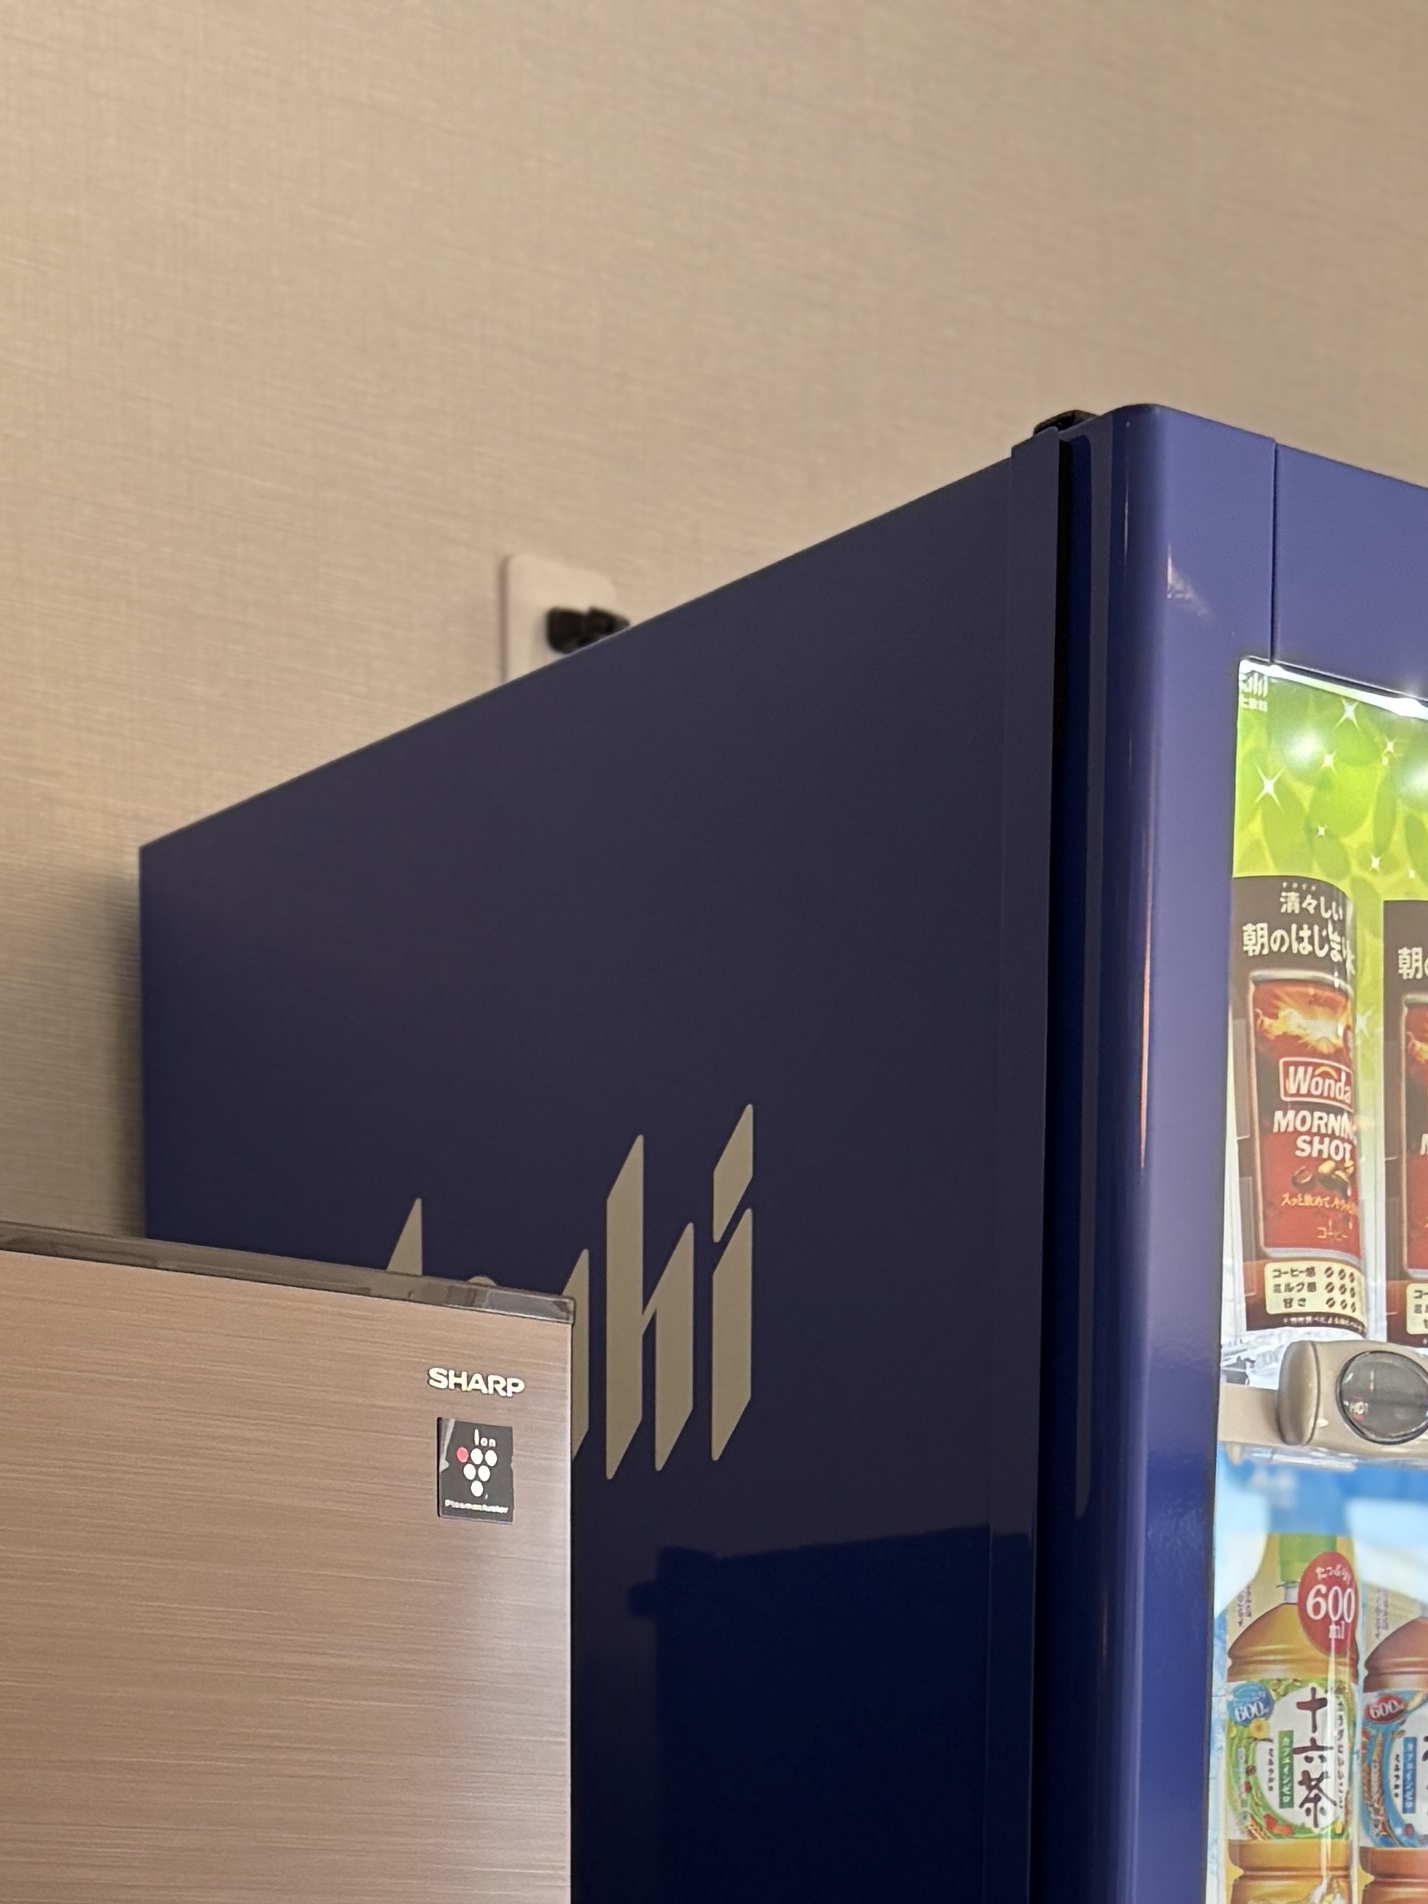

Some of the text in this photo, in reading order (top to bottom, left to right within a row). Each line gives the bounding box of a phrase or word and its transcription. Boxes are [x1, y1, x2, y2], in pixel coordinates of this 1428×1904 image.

[1280, 892, 1343, 920] 清々しい
[1288, 1066, 1352, 1101] Wonda
[1295, 1135, 1353, 1161] SHOT
[1283, 1297, 1307, 1308] 甘さ
[428, 1368, 525, 1398] SHARP
[474, 1428, 497, 1448] Ion
[1305, 1584, 1355, 1624] 600
[1292, 1686, 1338, 1829] 十六茶
